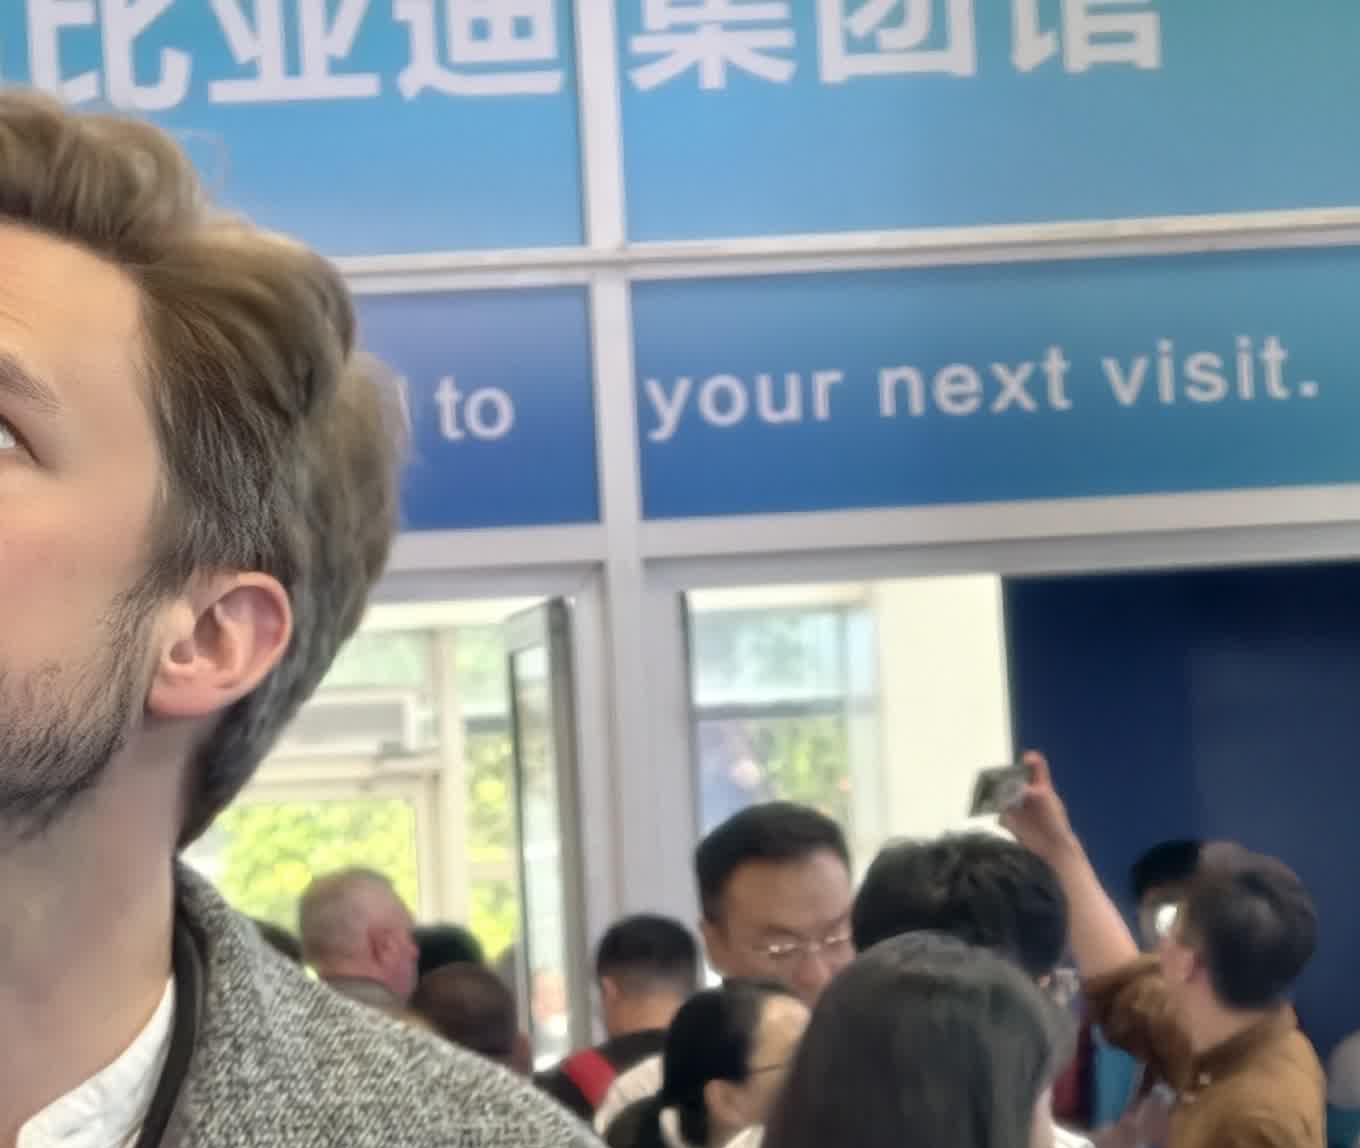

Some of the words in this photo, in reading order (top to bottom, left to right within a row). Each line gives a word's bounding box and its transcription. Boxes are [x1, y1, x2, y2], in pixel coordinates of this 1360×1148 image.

[433, 374, 514, 441] to
[644, 366, 844, 443] your
[876, 344, 1073, 420] next
[1101, 334, 1321, 408] visit.
